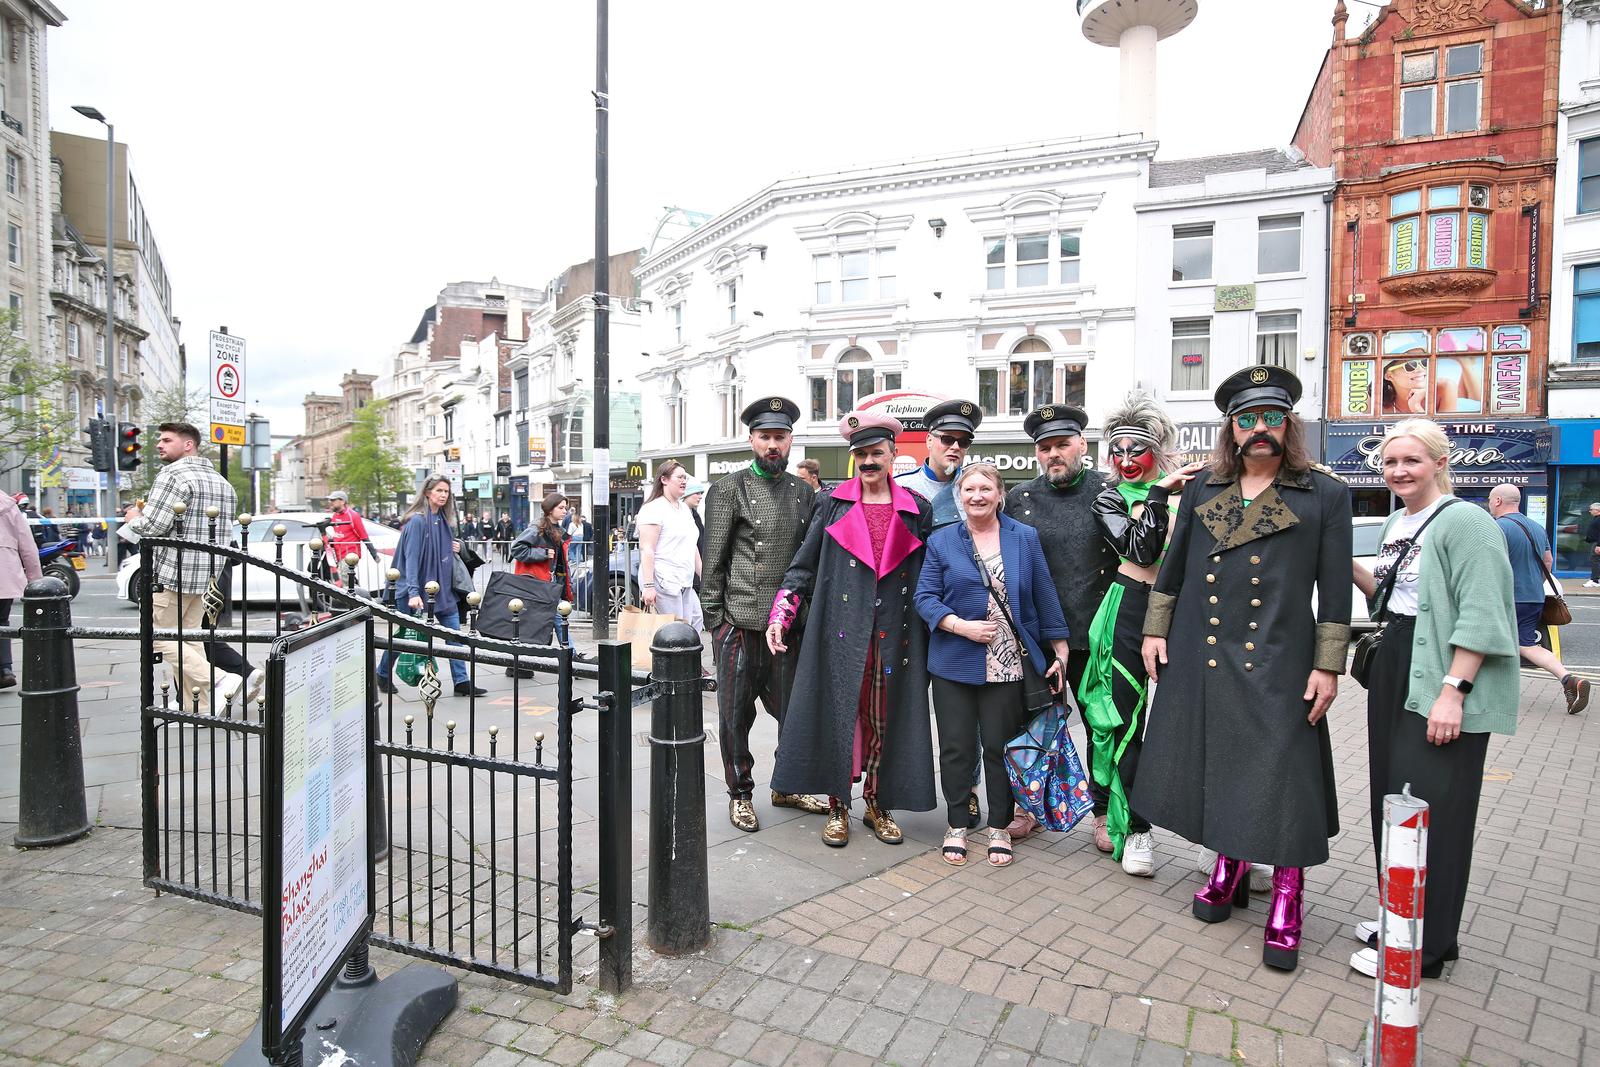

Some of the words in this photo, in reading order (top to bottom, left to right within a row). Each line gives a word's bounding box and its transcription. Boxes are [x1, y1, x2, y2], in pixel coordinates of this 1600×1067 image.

[1396, 222, 1414, 271] SUNBEDS
[1434, 216, 1454, 267] SUNBEDS
[1470, 216, 1483, 266] SUNBEDS
[212, 333, 243, 347] PEDESTRIAN
[225, 344, 240, 353] CYCLE
[217, 350, 239, 363] ZONE
[1496, 332, 1523, 411] TANFAST
[885, 404, 928, 415] Telephone
[910, 421, 928, 429] Car
[1455, 424, 1496, 434] TIME
[1179, 426, 1222, 450] CALI
[1178, 453, 1214, 463] ONVEN
[1358, 435, 1505, 475] Cino
[1481, 475, 1529, 484] CENTRE
[282, 844, 328, 912] Shanghai
[302, 888, 330, 928] Restaurant
[333, 890, 349, 921] Fresh
